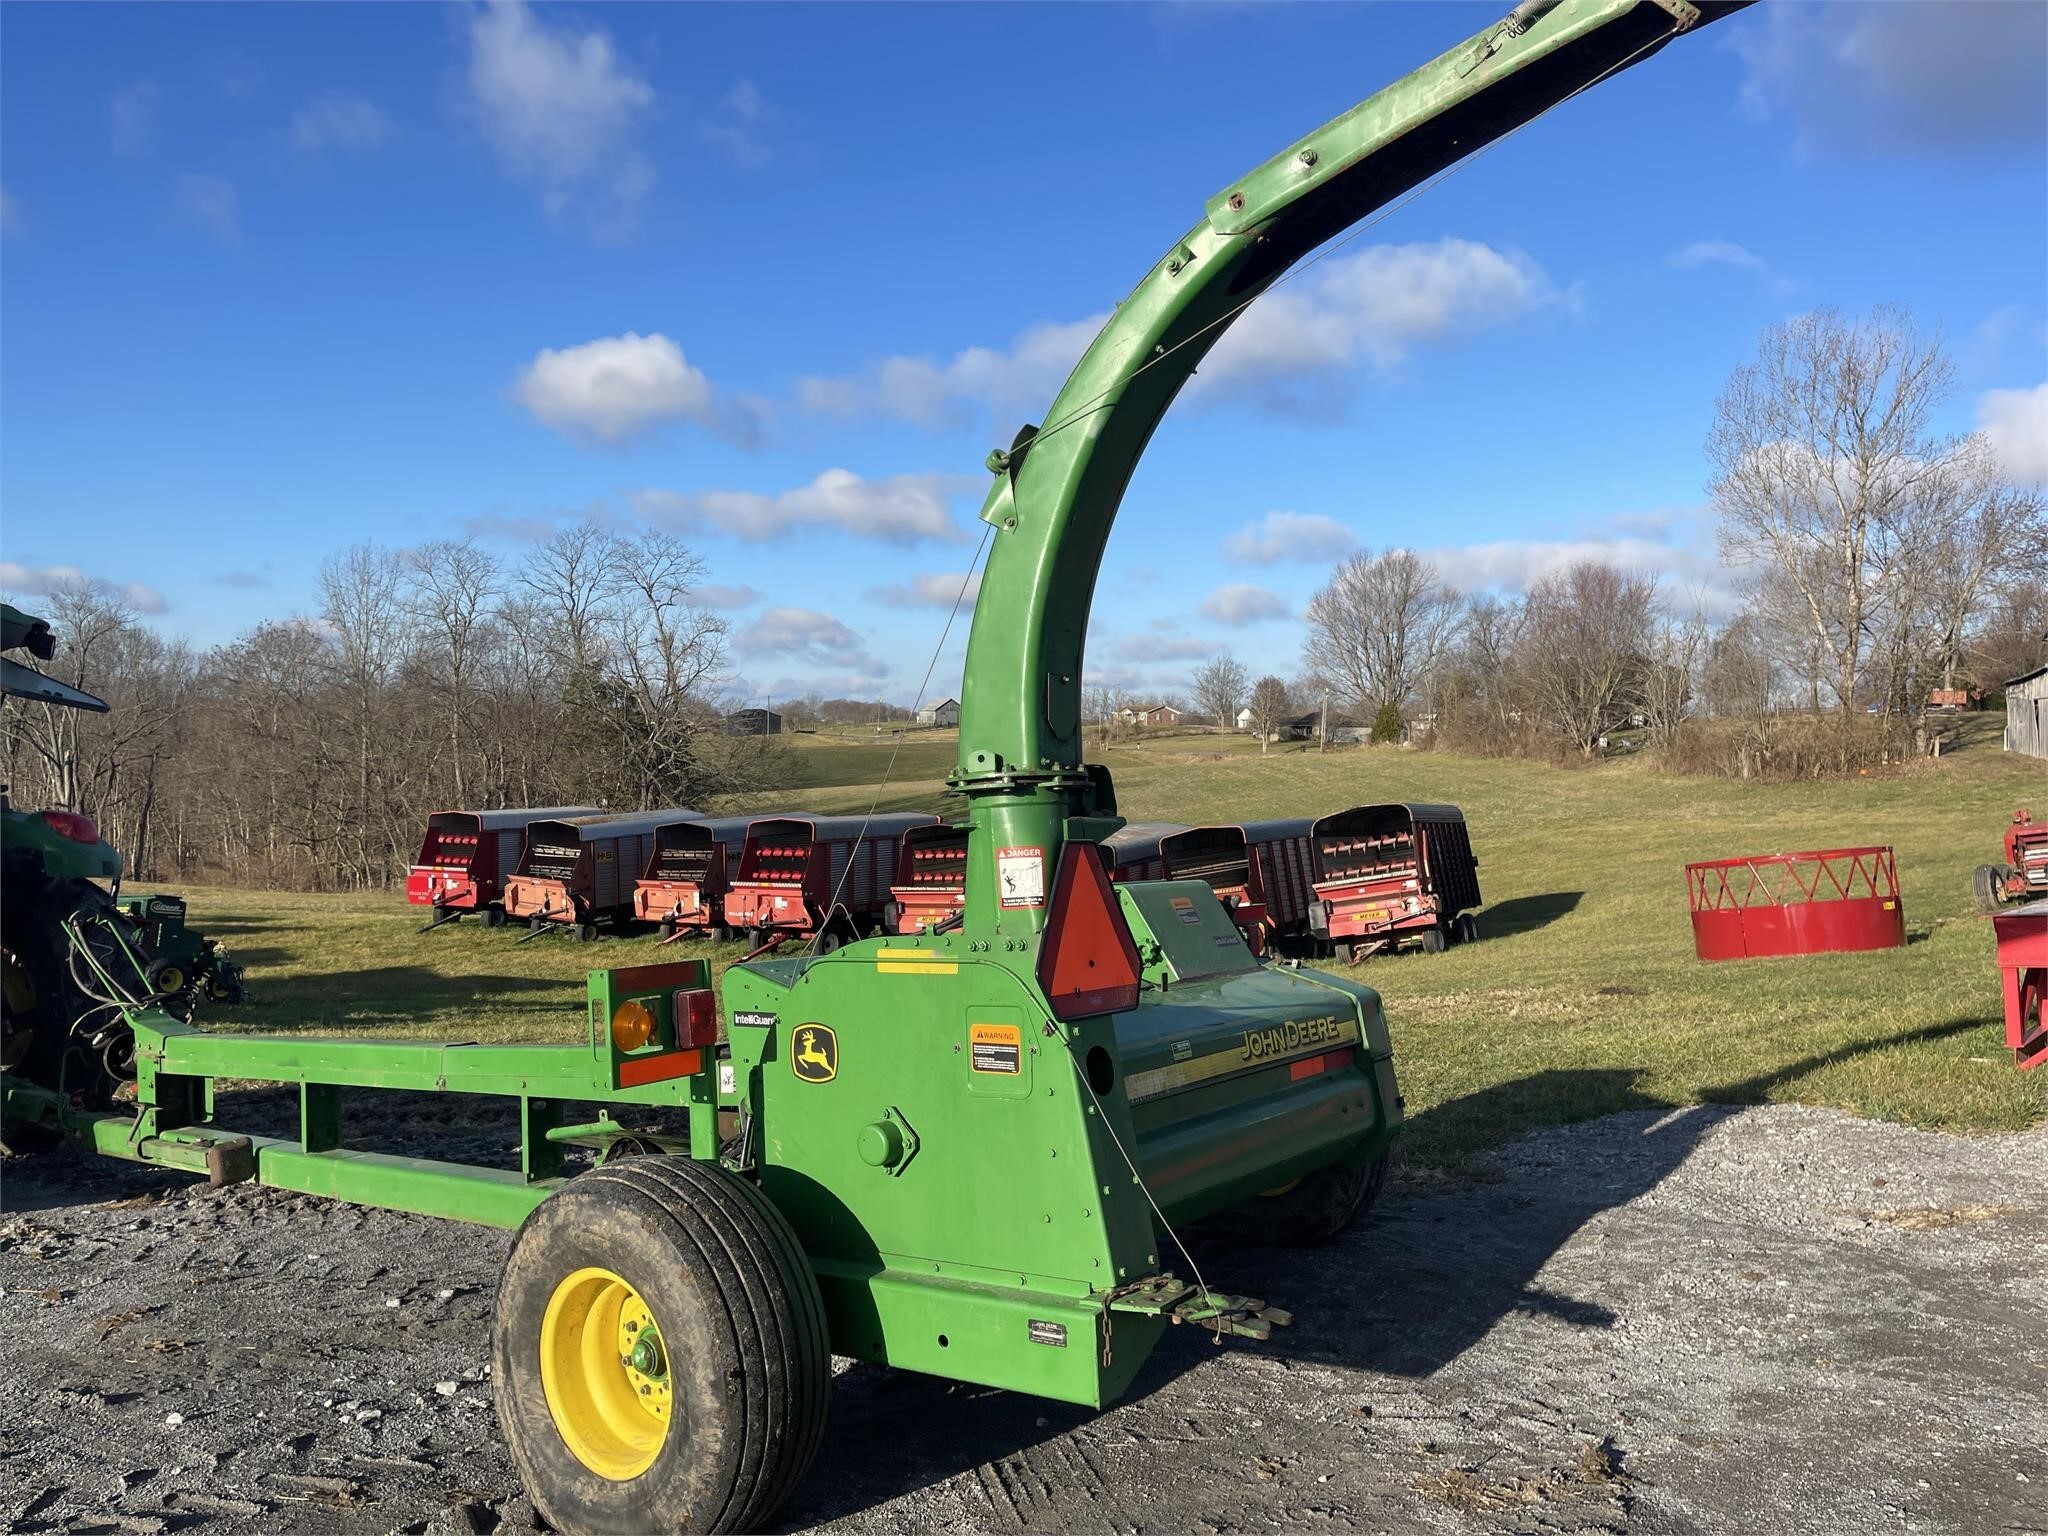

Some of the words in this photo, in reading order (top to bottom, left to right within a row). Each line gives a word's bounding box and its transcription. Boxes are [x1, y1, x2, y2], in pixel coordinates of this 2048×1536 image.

[1007, 849, 1041, 857] DANGER
[984, 1031, 1014, 1041] WARNING
[1241, 1029, 1286, 1058] JOHN
[1285, 1016, 1338, 1047] DEERE
